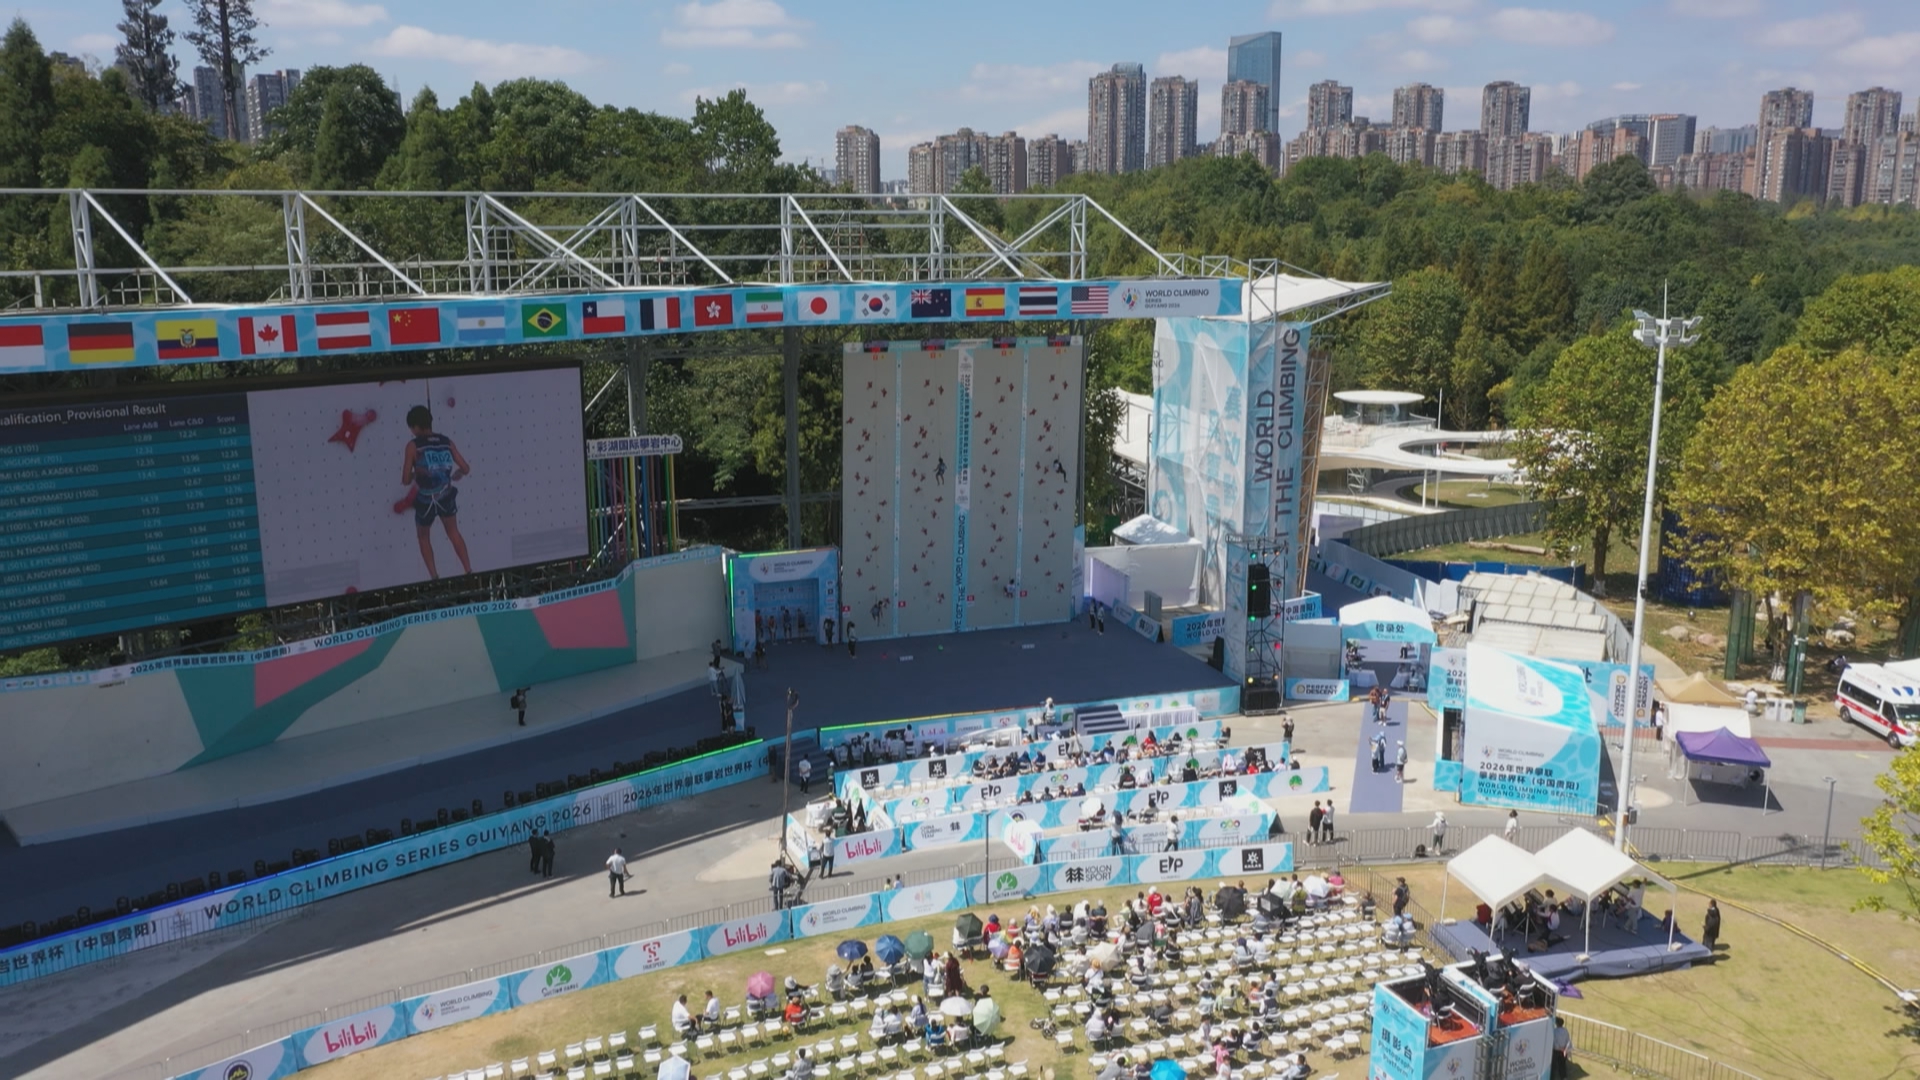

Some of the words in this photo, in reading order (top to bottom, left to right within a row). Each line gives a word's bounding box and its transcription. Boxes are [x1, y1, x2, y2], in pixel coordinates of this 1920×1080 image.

[1145, 289, 1172, 298] WORLD
[1173, 288, 1209, 297] CLIMBING
[1278, 328, 1300, 450] CLIMBING
[133, 403, 166, 416] Result
[169, 419, 186, 428] Lane
[217, 415, 235, 423] Score
[219, 427, 236, 435] 12.24
[1254, 390, 1275, 484] WORLD
[1275, 467, 1293, 522] THE
[235, 590, 251, 598] FALL
[313, 631, 353, 648] WORLD
[402, 612, 438, 626] SERIES
[440, 603, 488, 619] GUIYANG
[491, 601, 518, 612] 2026
[1186, 629, 1211, 639] WORLD
[1478, 781, 1506, 790] WORLD
[1509, 785, 1548, 795] CLIMBING
[1478, 788, 1514, 797] GUIYANG
[1516, 791, 1536, 800] 2026
[845, 838, 882, 860] bilibili
[204, 887, 281, 920] WORLD
[289, 858, 388, 897] CLIMBING
[395, 839, 460, 867] SERIES
[466, 814, 546, 847] GUIYANG
[551, 803, 592, 824] 2026
[1085, 865, 1112, 873] KOLON
[1085, 873, 1112, 882] SPORT
[724, 922, 767, 947] bilibili
[440, 997, 462, 1007] WORLD
[463, 989, 493, 1002] CLIMBING
[324, 1020, 378, 1053] bilibili
[1510, 1057, 1533, 1067] WORLD
